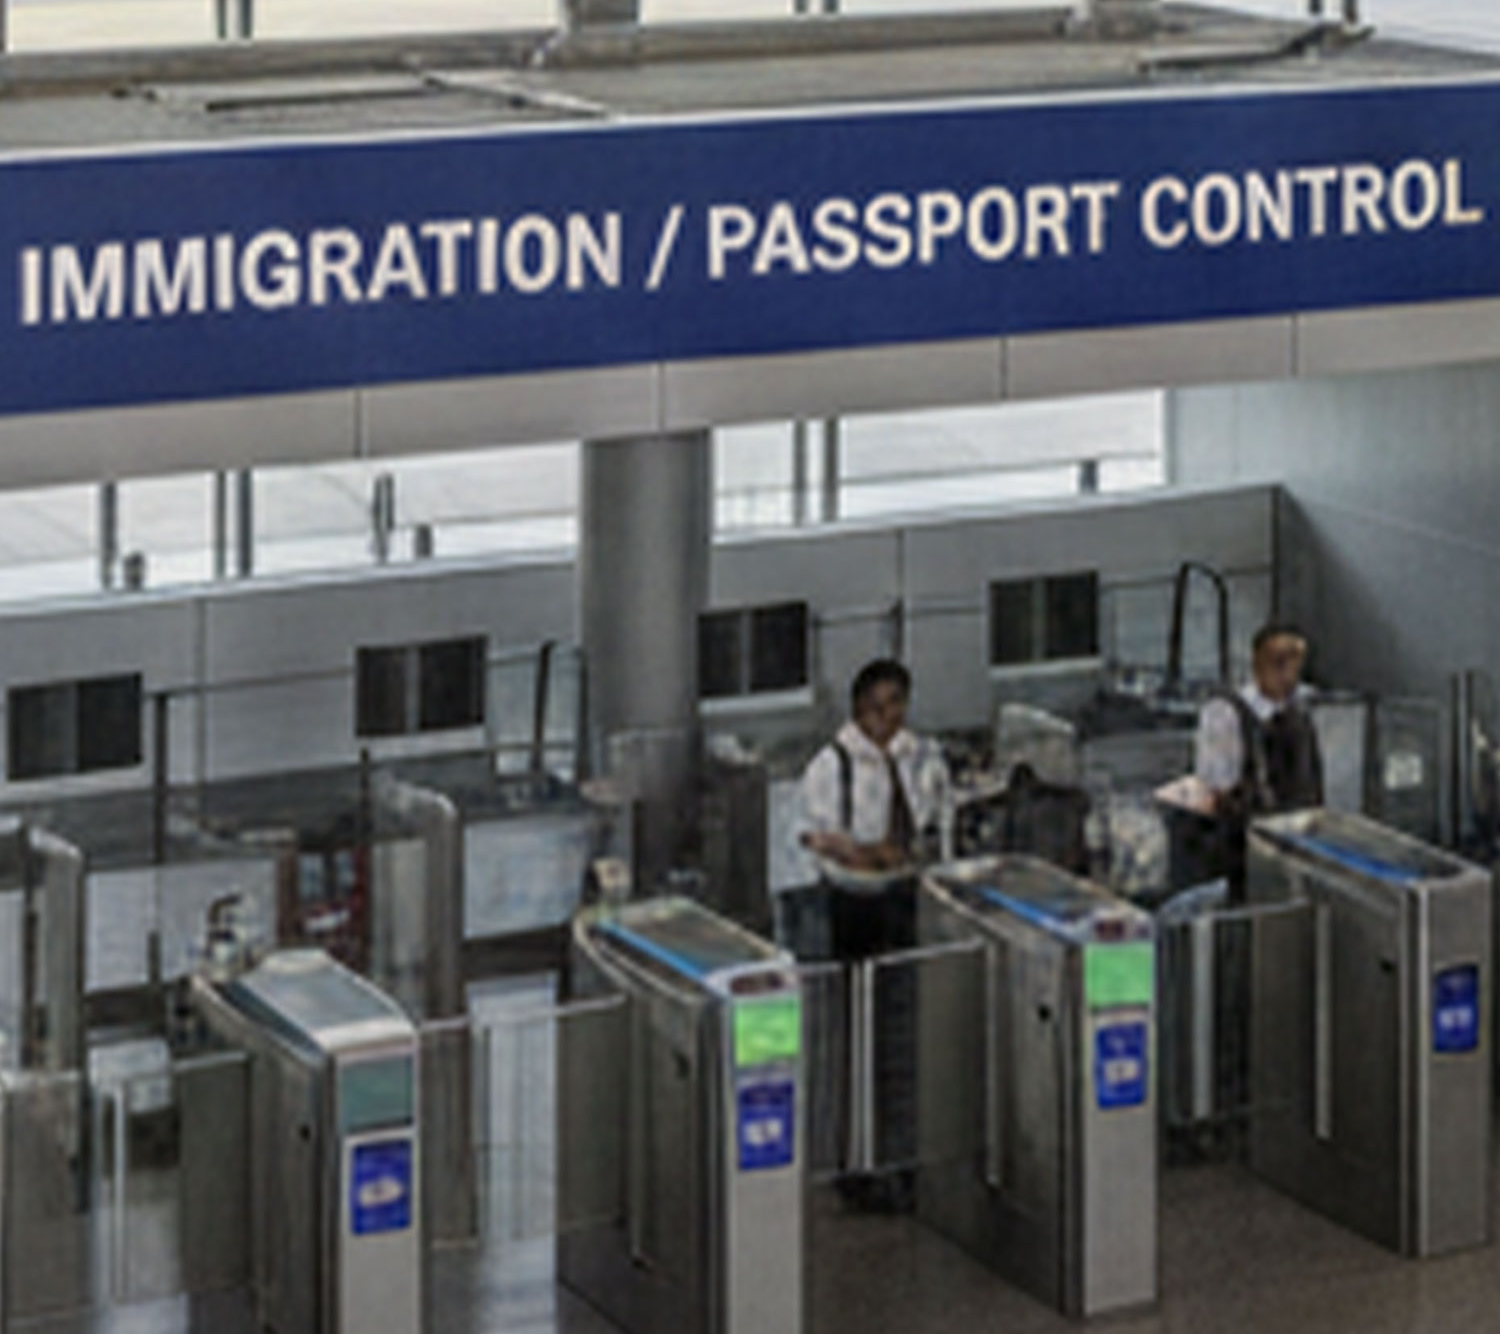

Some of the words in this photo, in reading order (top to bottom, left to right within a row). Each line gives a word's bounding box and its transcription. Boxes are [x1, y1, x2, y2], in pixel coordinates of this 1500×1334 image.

[20, 212, 621, 324] IMMIGRATION
[646, 205, 684, 289] /
[707, 181, 1121, 278] PASSPORT
[1140, 159, 1483, 247] CONTROL
